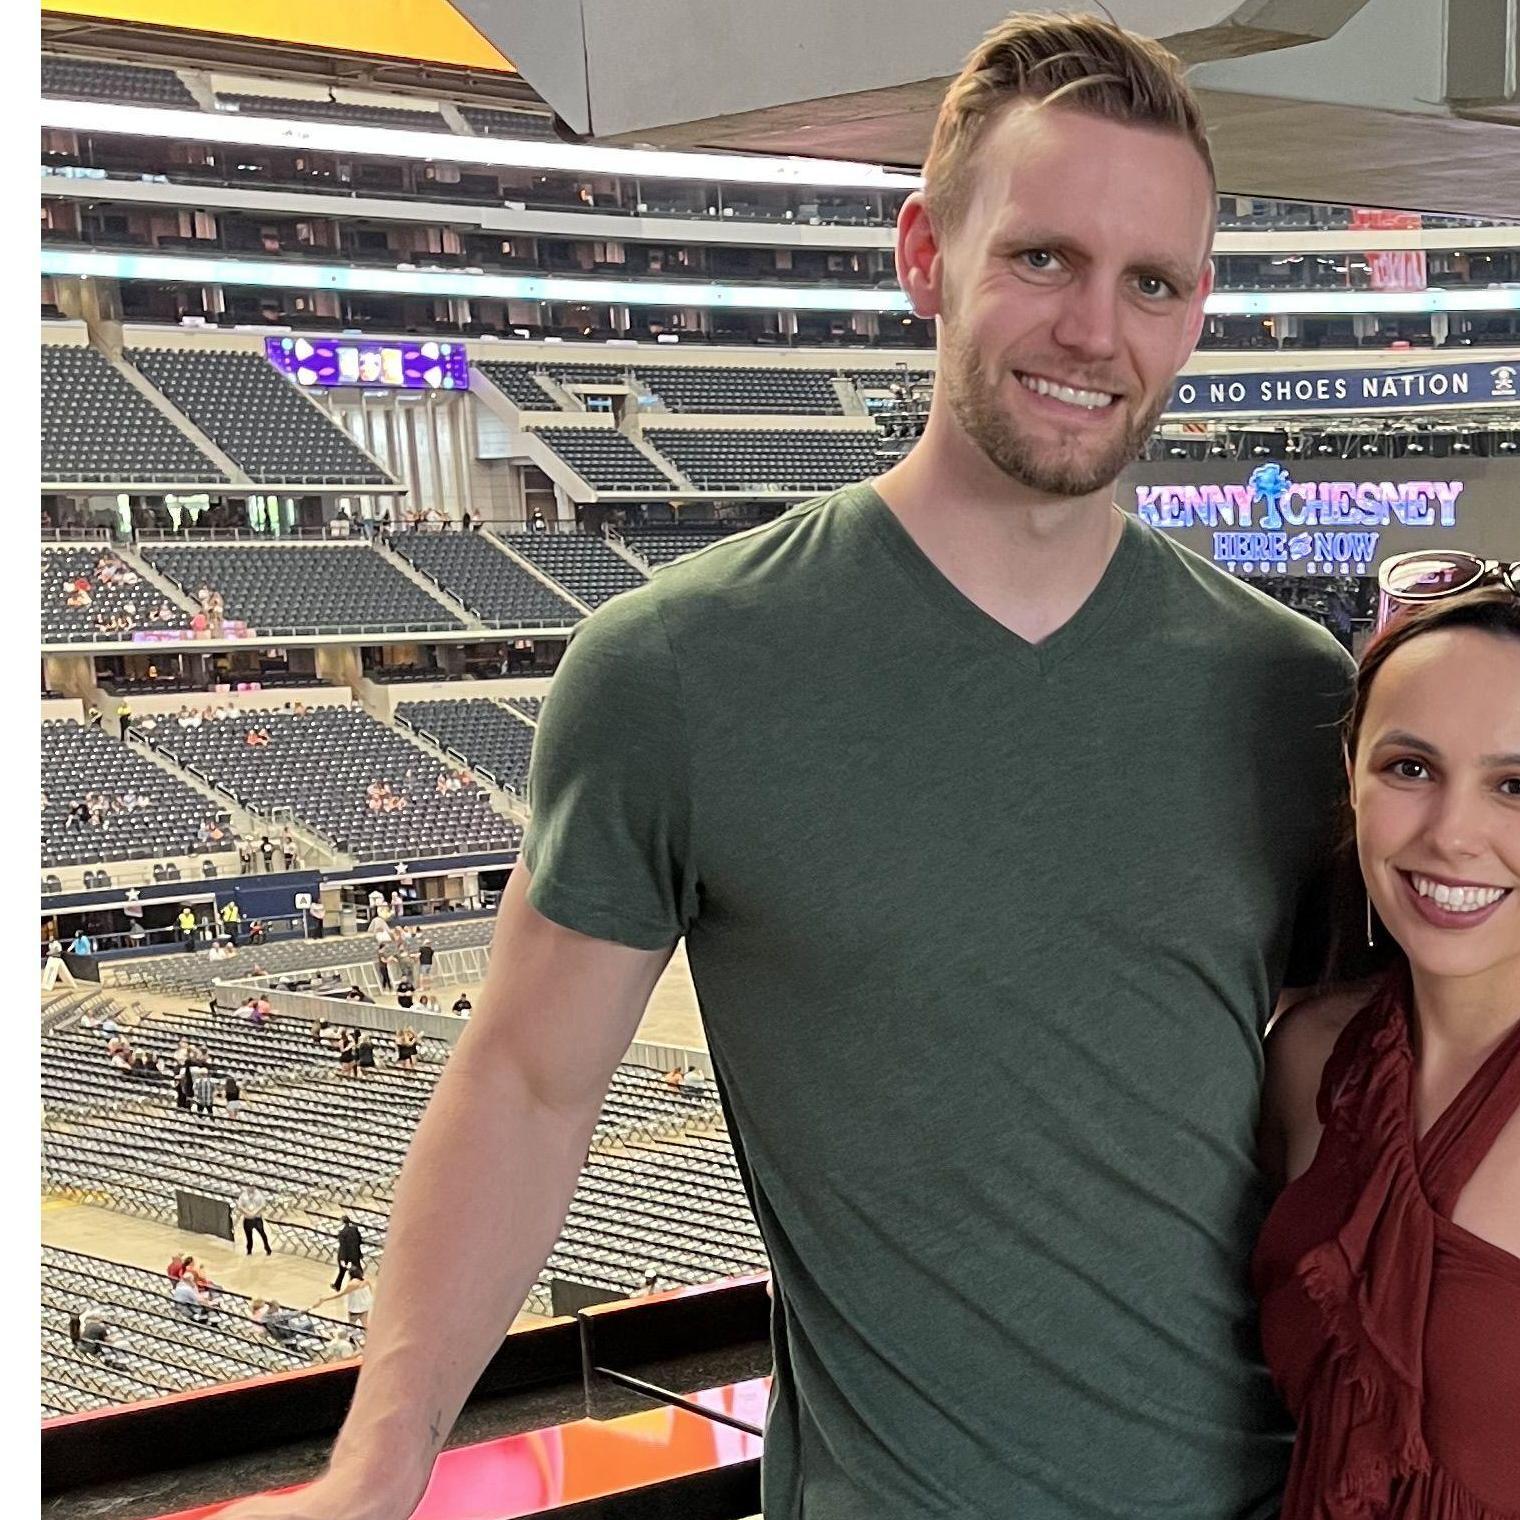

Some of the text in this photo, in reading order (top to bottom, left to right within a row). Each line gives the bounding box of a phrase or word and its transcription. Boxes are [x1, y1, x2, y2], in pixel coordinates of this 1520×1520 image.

[1210, 382, 1246, 403] NO
[1260, 378, 1347, 401] SHOES
[1362, 372, 1469, 398] NATION
[1135, 481, 1464, 528] KENNY CHESNEY
[1213, 531, 1288, 561] HERE
[1313, 532, 1379, 562] NOW
